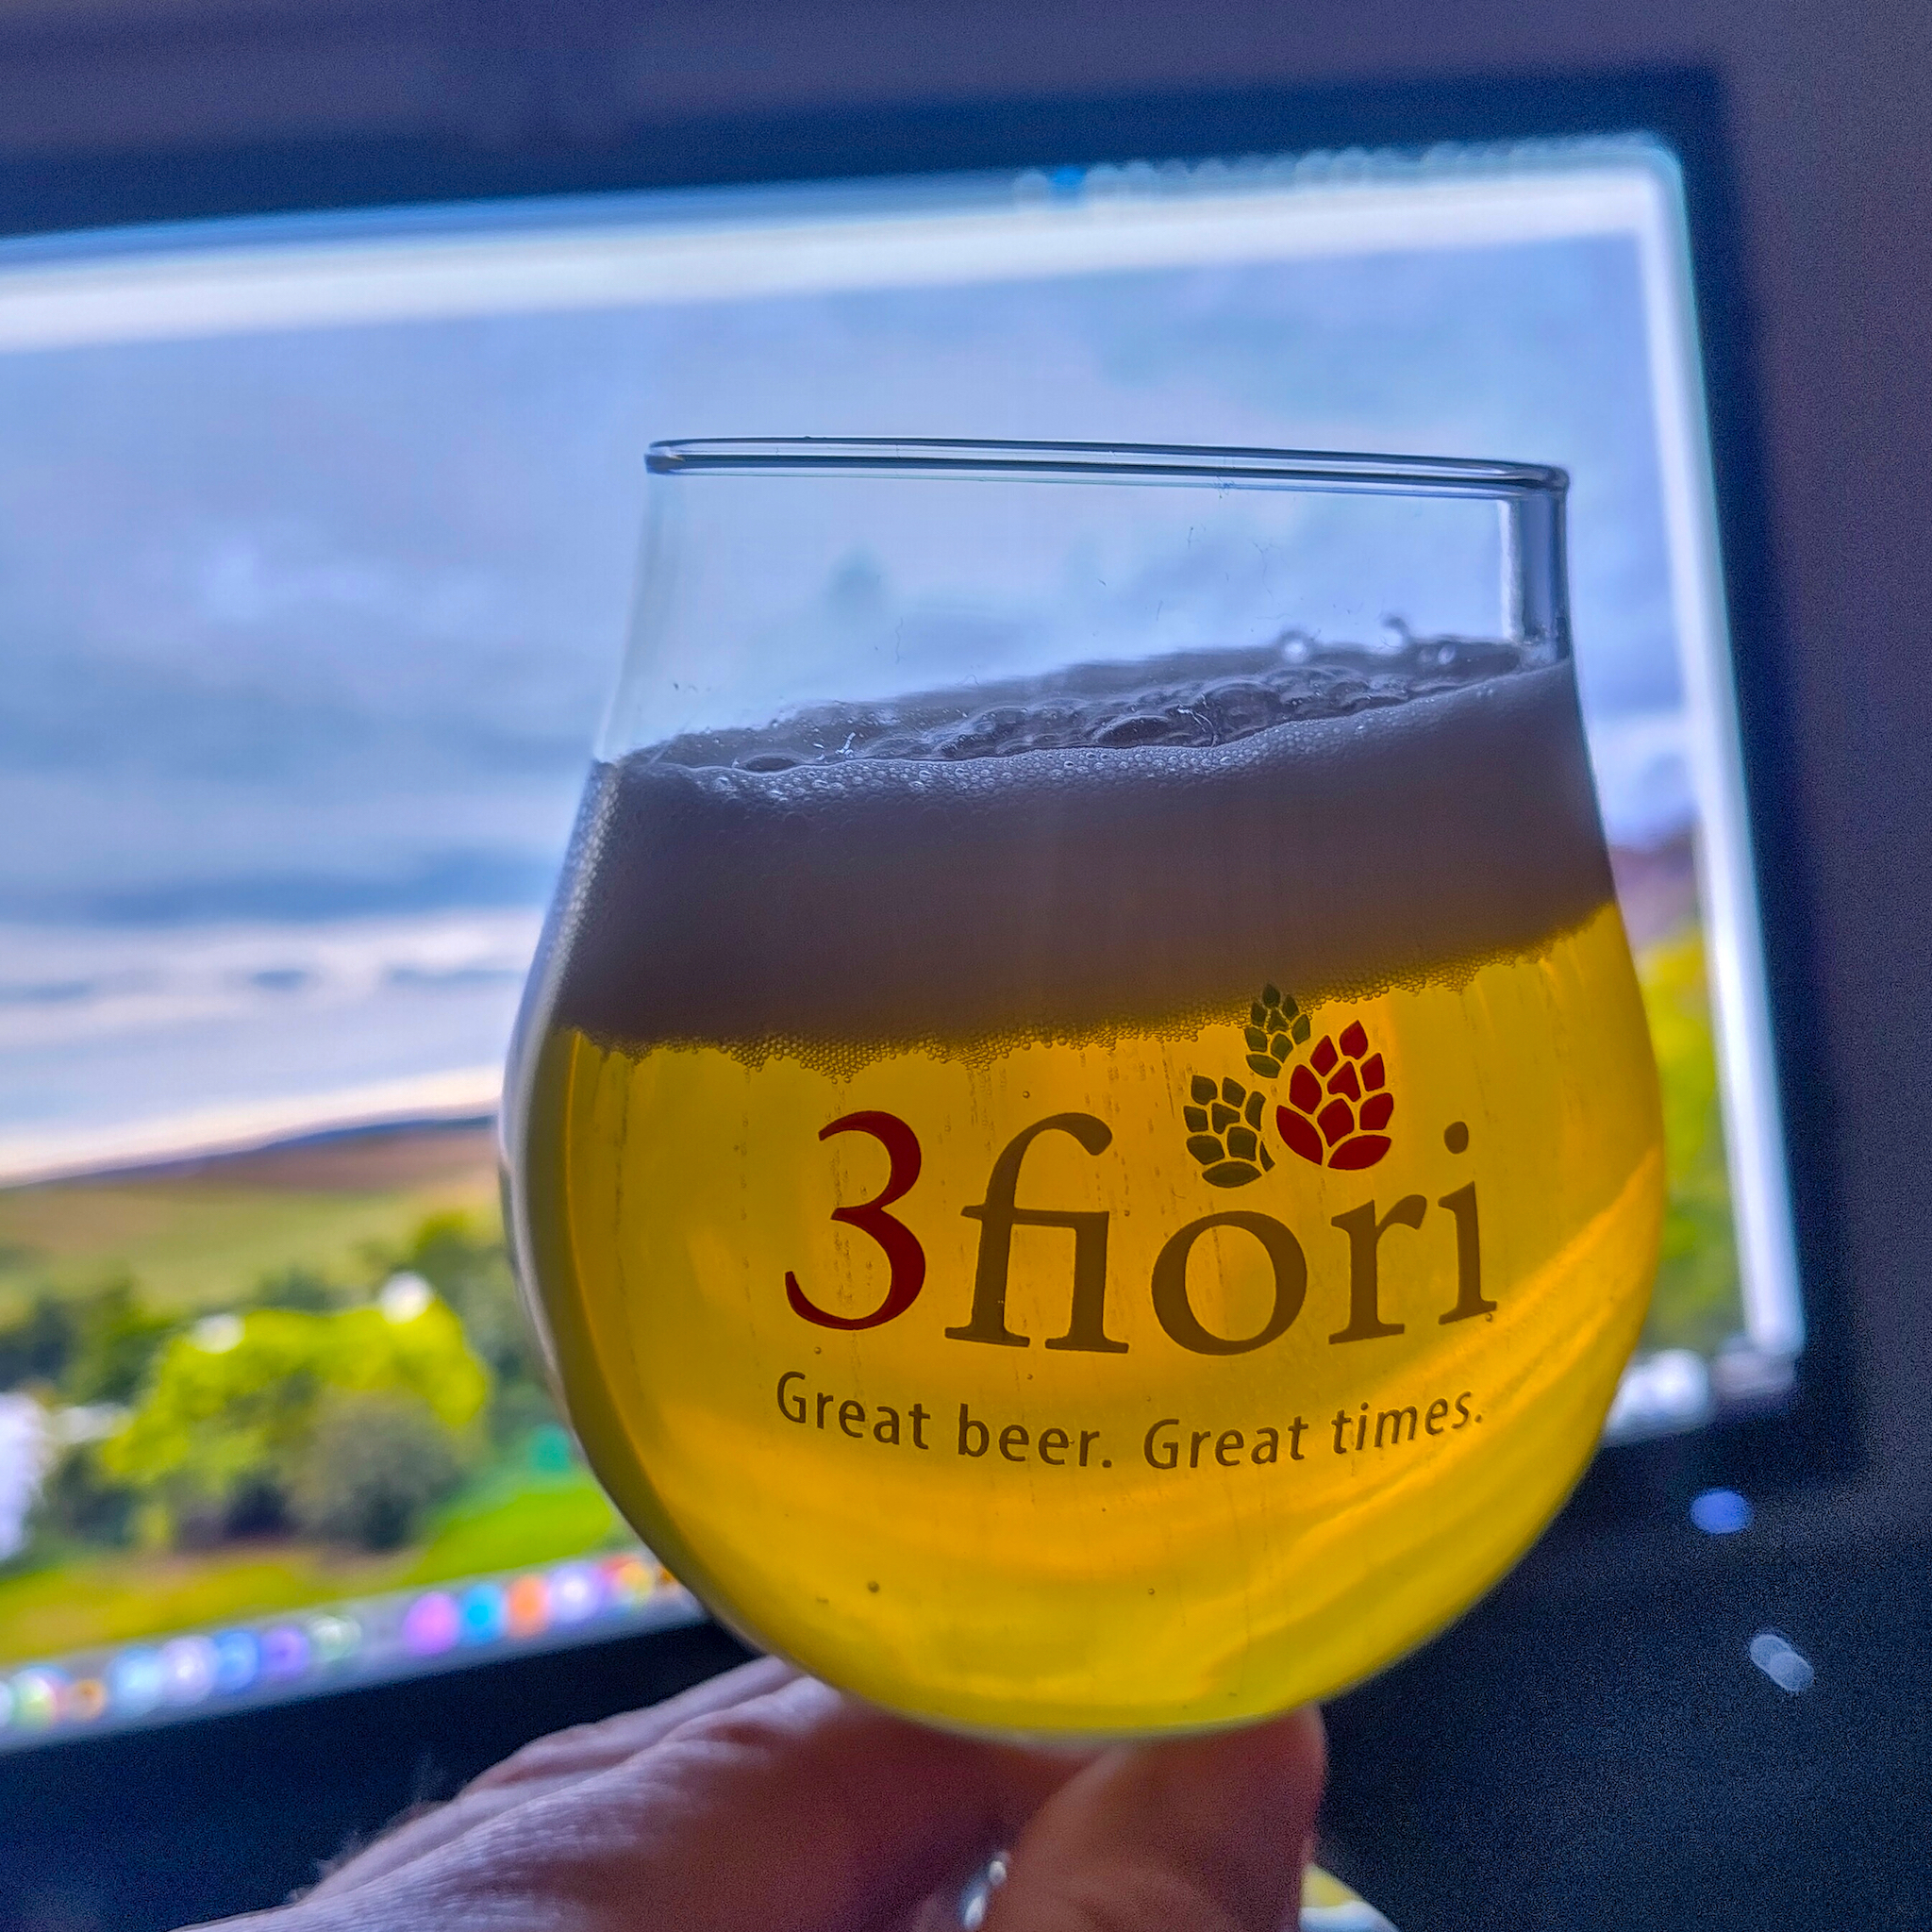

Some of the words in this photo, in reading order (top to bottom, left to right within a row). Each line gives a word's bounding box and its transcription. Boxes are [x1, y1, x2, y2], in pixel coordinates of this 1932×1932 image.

[784, 1110, 1497, 1355] 3fiori
[776, 1371, 930, 1450] Great
[957, 1403, 1113, 1469] beer.
[1143, 1417, 1309, 1470] Great
[1331, 1390, 1484, 1457] times.
